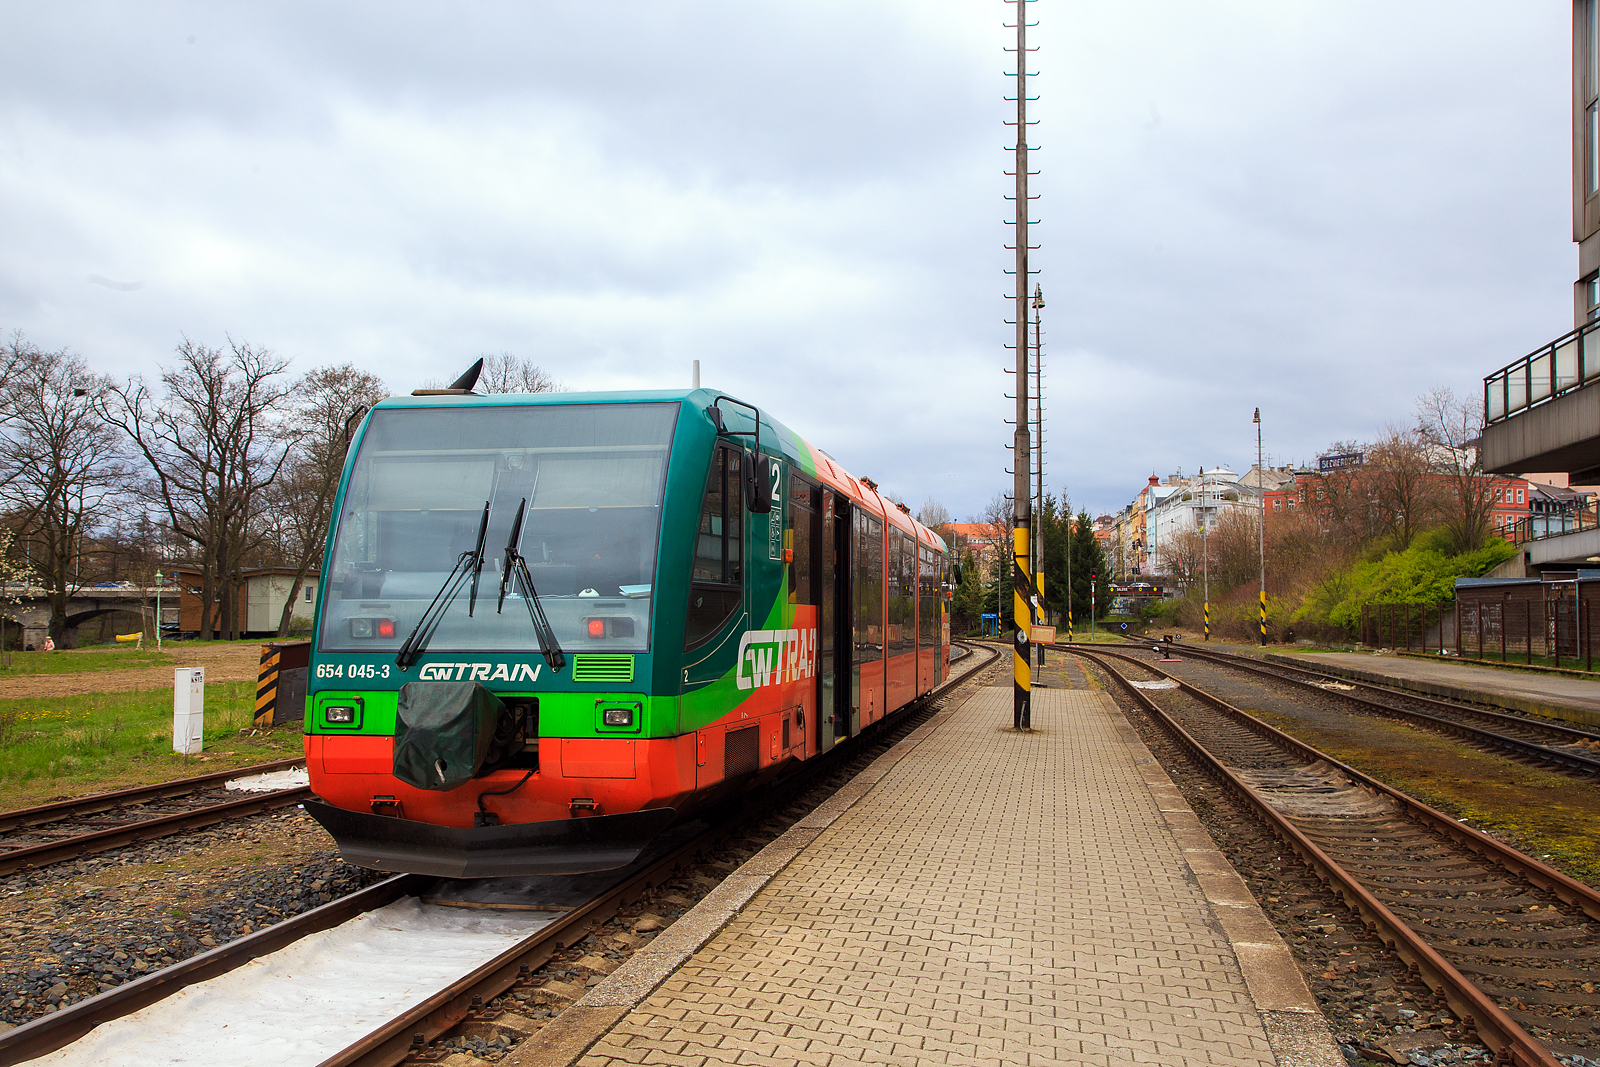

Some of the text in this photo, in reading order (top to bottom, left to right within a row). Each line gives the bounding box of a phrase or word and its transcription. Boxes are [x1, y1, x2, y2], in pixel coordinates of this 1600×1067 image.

[771, 463, 780, 501] 2
[316, 663, 391, 679] 654 045-3
[683, 669, 689, 683] 2
